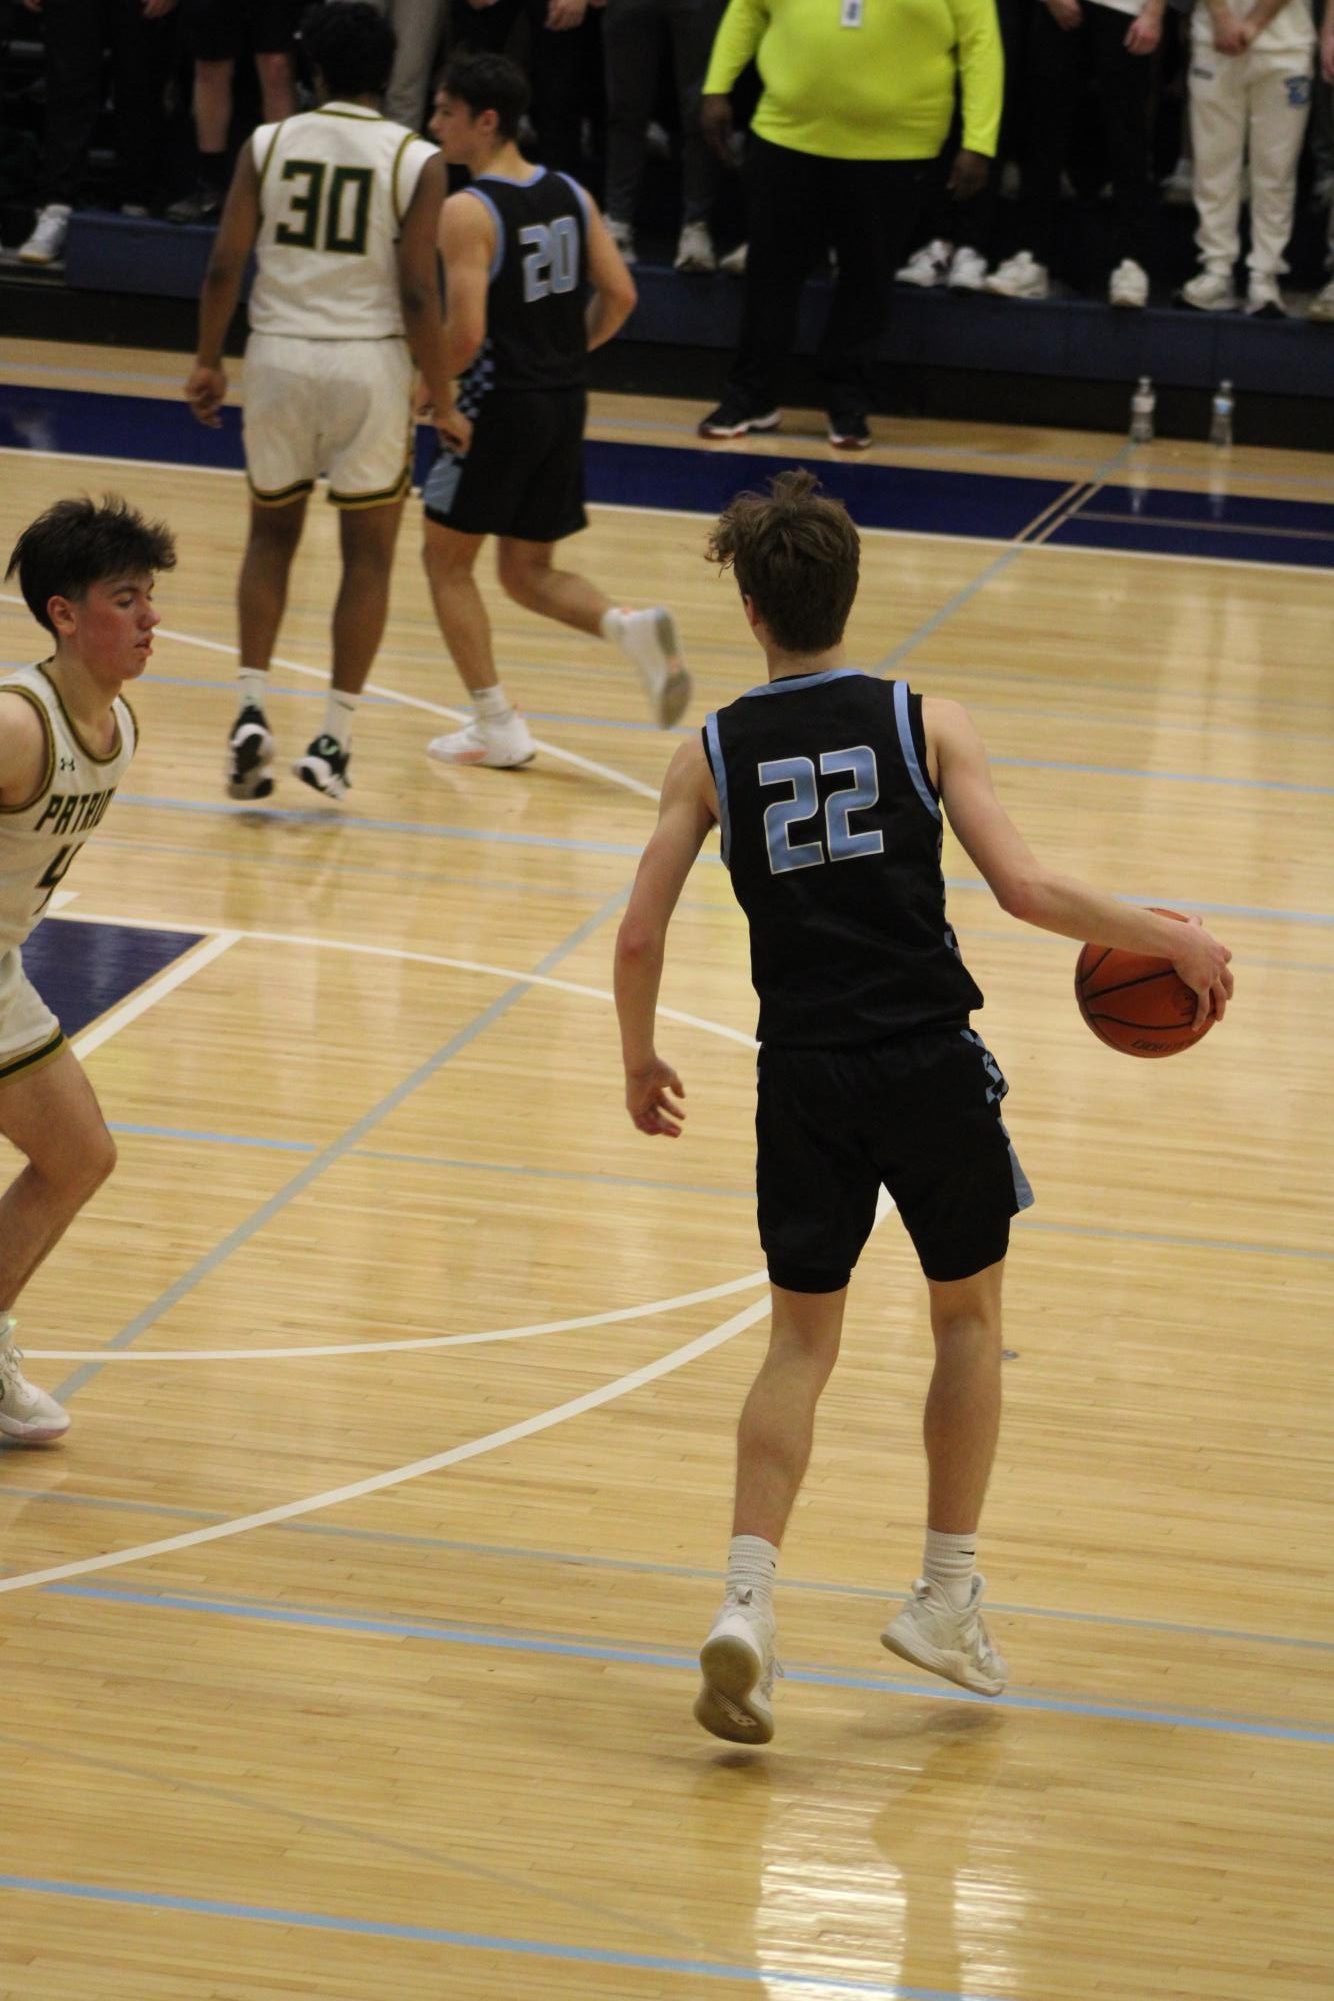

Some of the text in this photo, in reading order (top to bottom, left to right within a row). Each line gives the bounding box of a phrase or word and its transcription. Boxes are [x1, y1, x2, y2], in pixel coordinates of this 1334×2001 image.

[275, 159, 375, 256] 30
[519, 215, 580, 303] 20
[757, 745, 885, 875] 22
